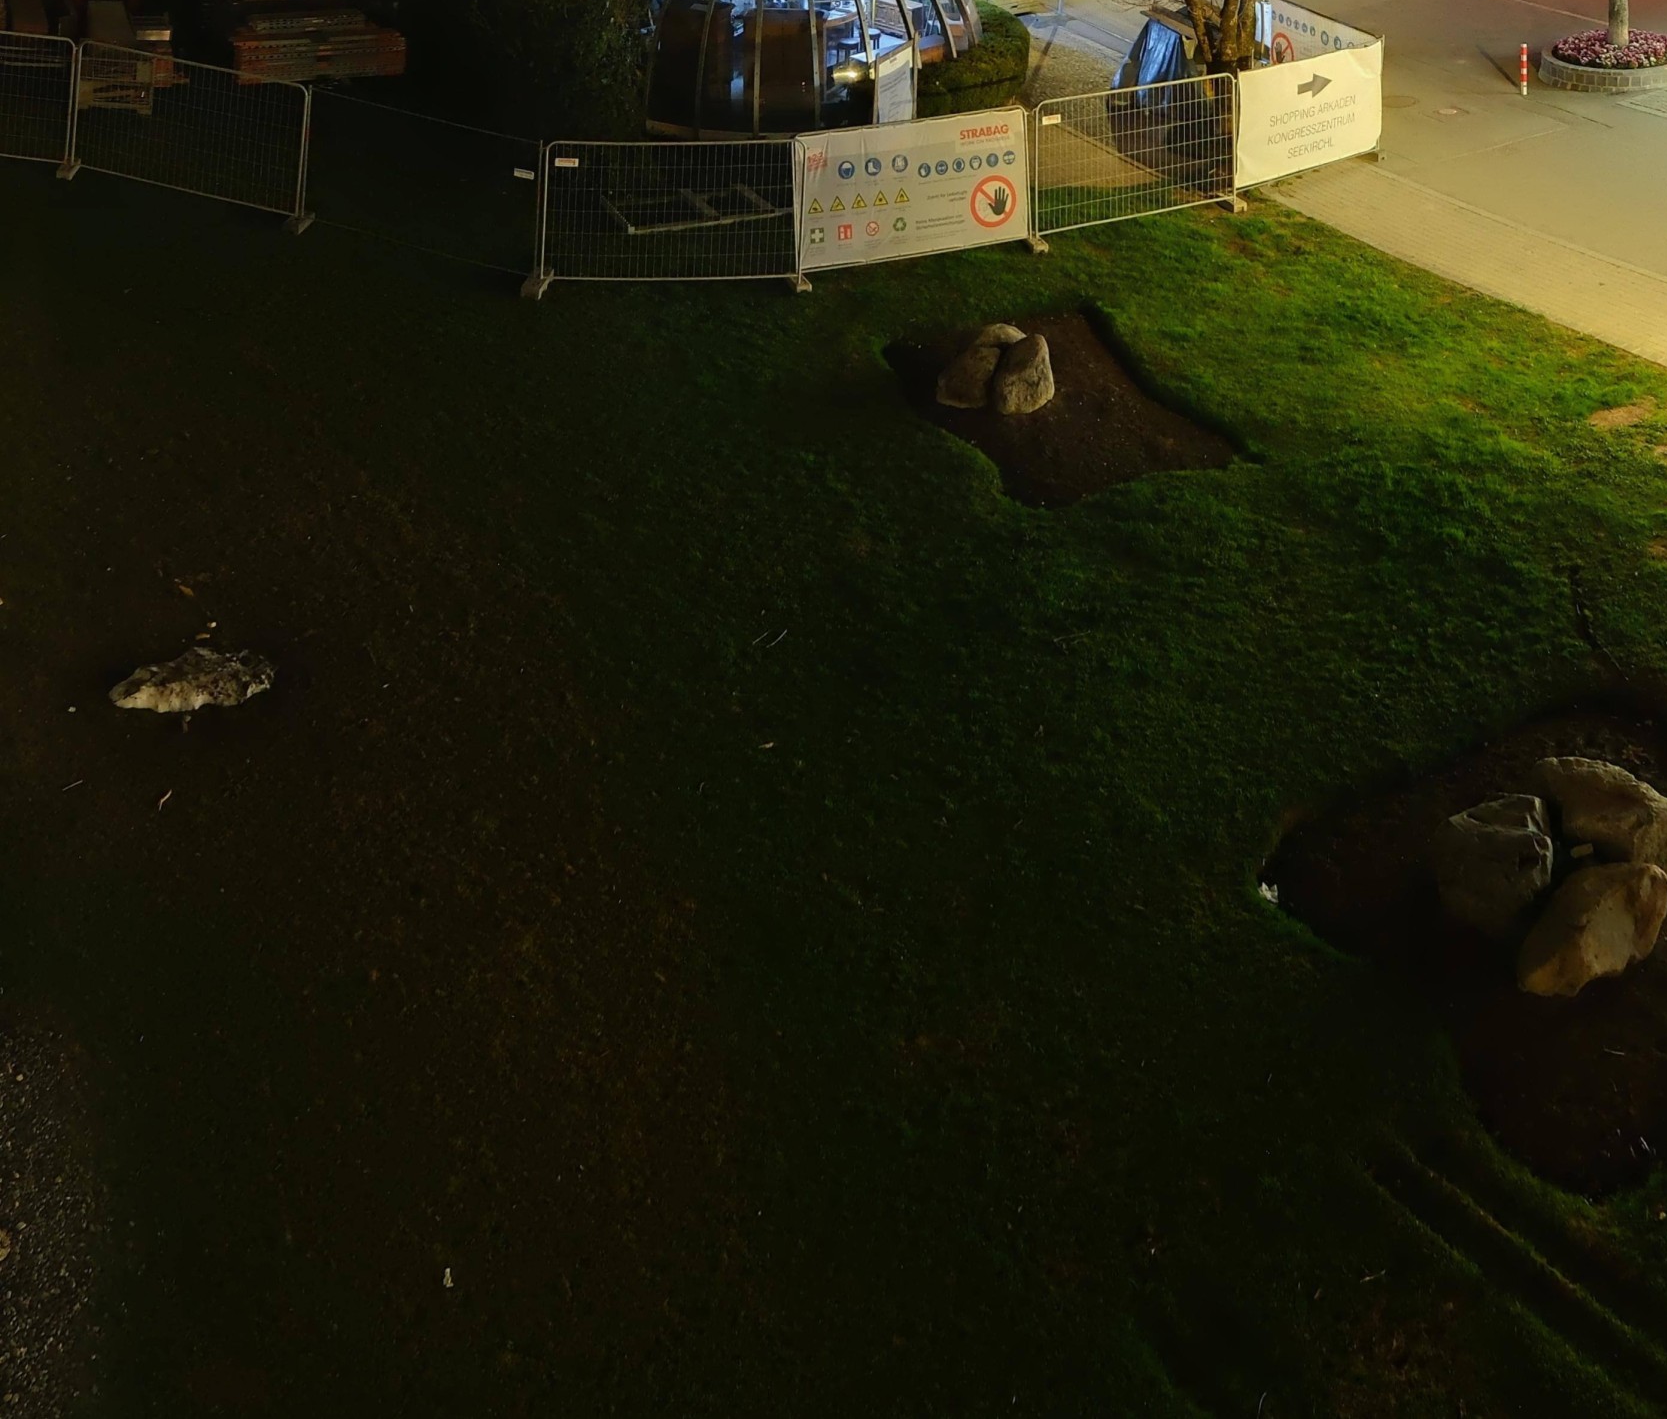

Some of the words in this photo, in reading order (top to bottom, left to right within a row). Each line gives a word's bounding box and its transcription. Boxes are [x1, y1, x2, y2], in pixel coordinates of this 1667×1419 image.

[1269, 106, 1316, 128] SHOPPING
[1317, 94, 1357, 116] ARKADEN
[960, 124, 1009, 141] STRABAG
[1267, 112, 1356, 146] KONGRESSZENTRUM
[1287, 136, 1335, 160] SEEKIRCHL
